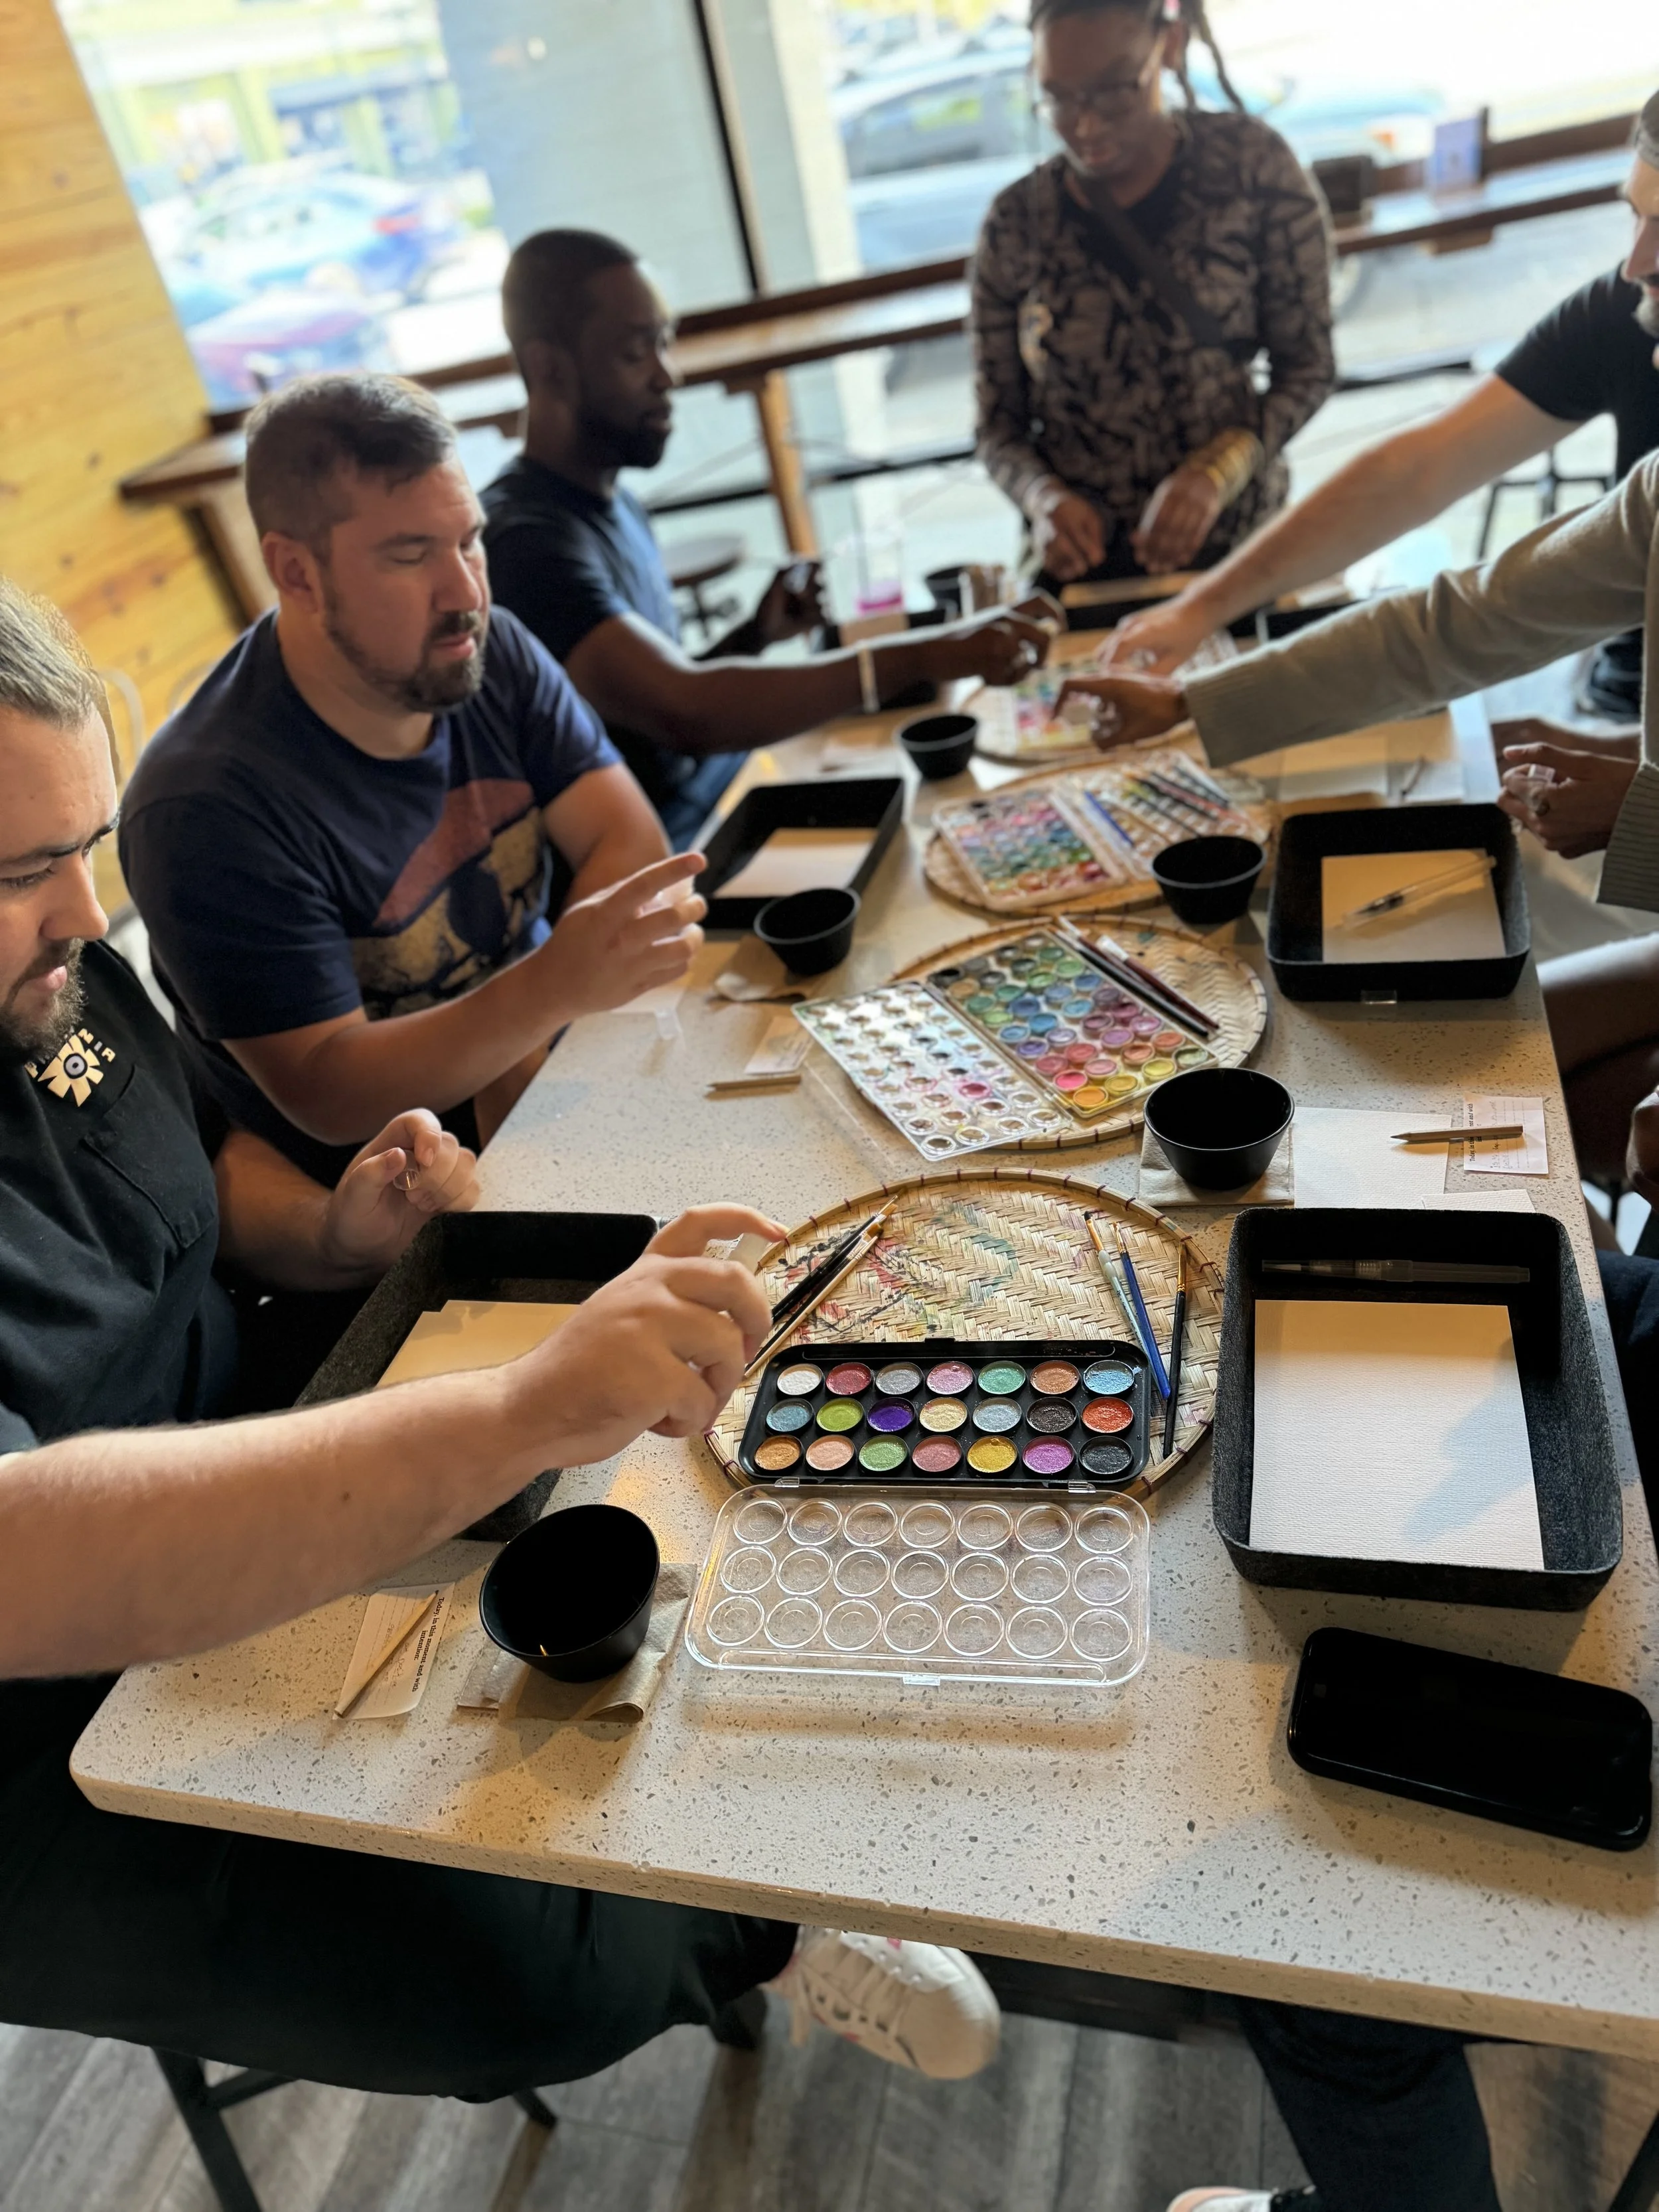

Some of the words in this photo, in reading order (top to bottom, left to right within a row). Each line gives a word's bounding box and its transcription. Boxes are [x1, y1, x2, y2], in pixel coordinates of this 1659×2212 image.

[433, 1597, 445, 1617] Today,
[420, 1638, 432, 1663] moment
[416, 1664, 425, 1676] and
[411, 1678, 421, 1692] with
